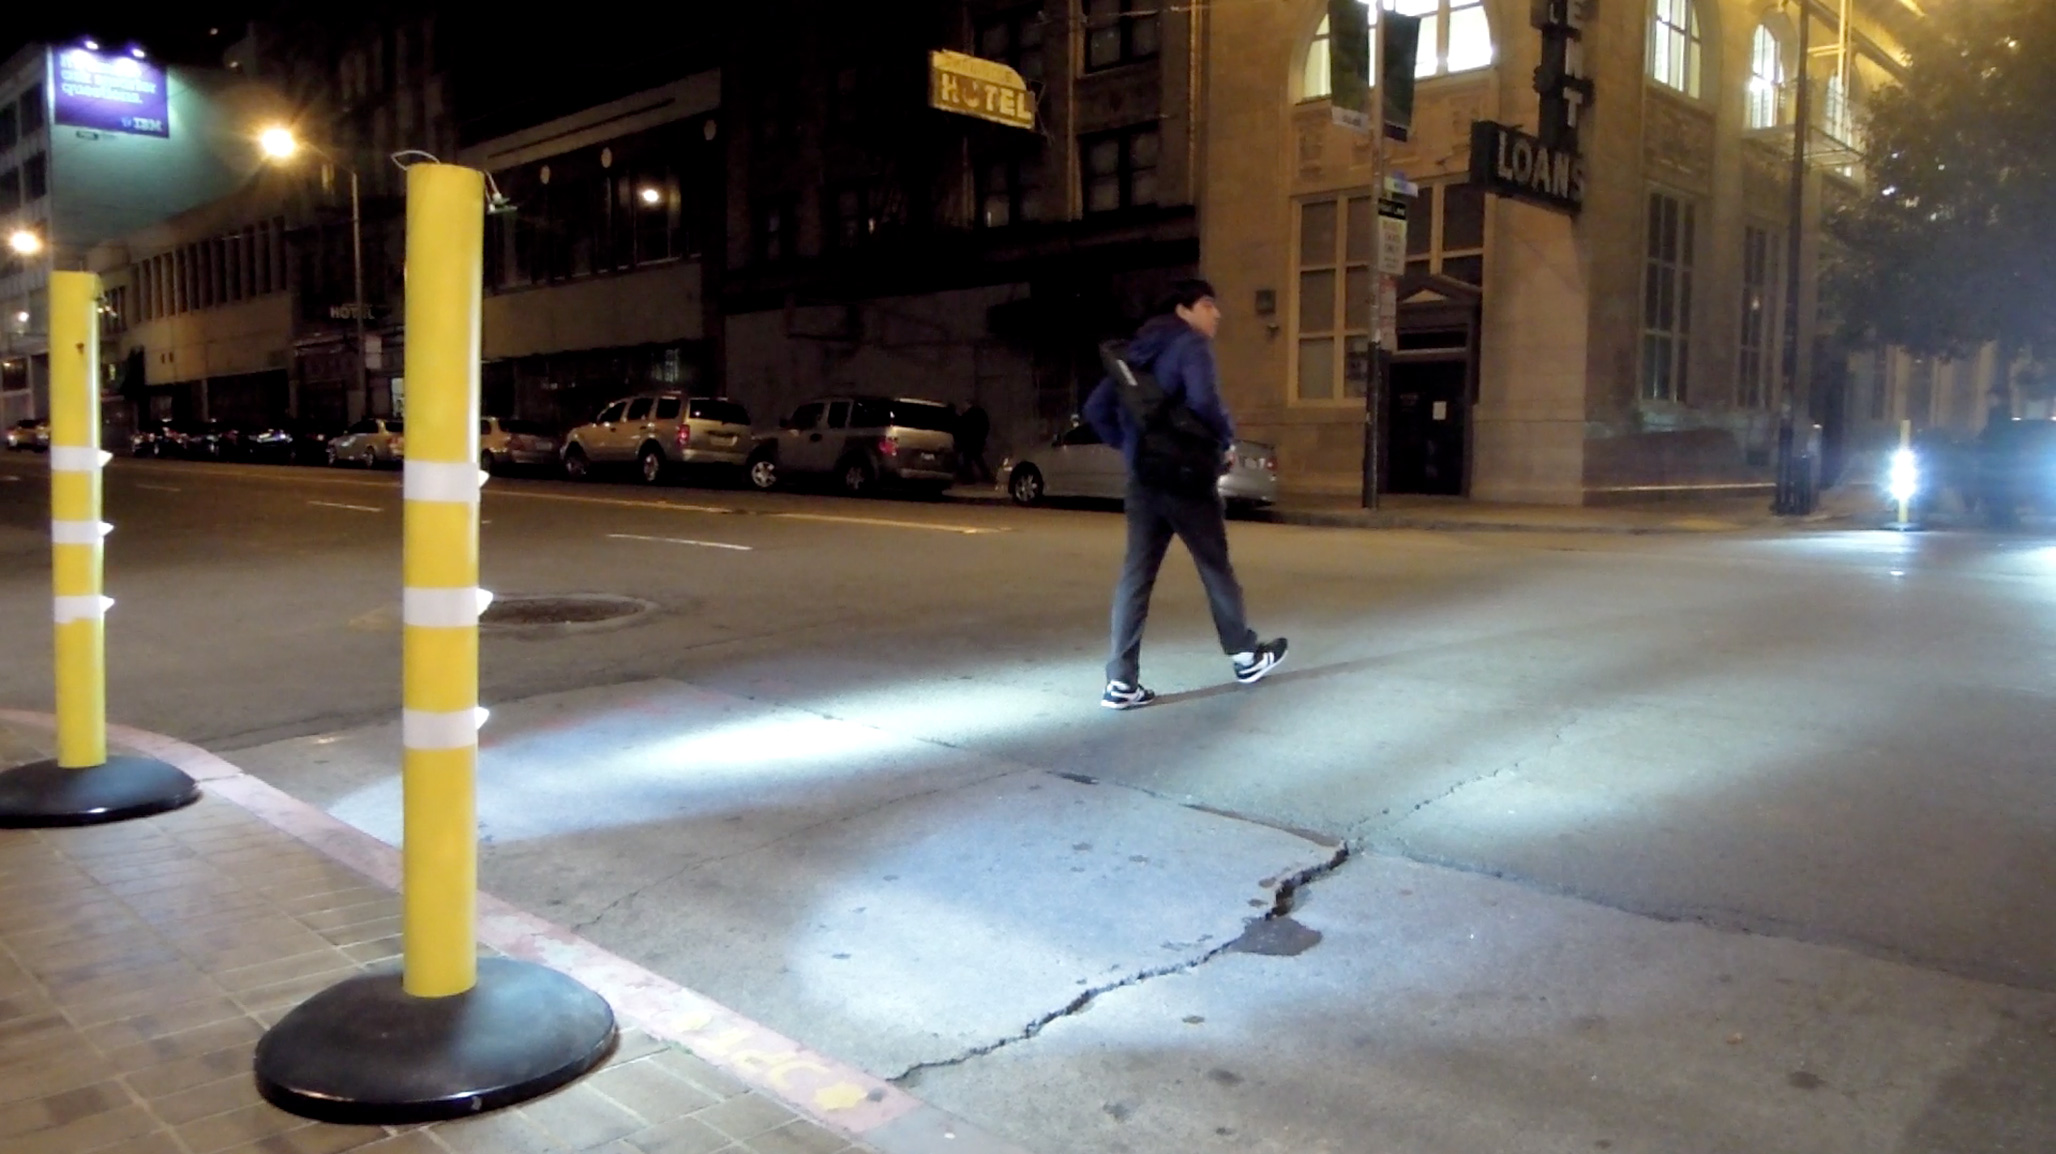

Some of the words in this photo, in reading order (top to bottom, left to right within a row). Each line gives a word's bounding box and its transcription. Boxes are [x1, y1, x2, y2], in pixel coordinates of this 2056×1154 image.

[941, 72, 1032, 120] HOTEL
[132, 116, 163, 131] IBM
[1497, 130, 1585, 202] LOANS
